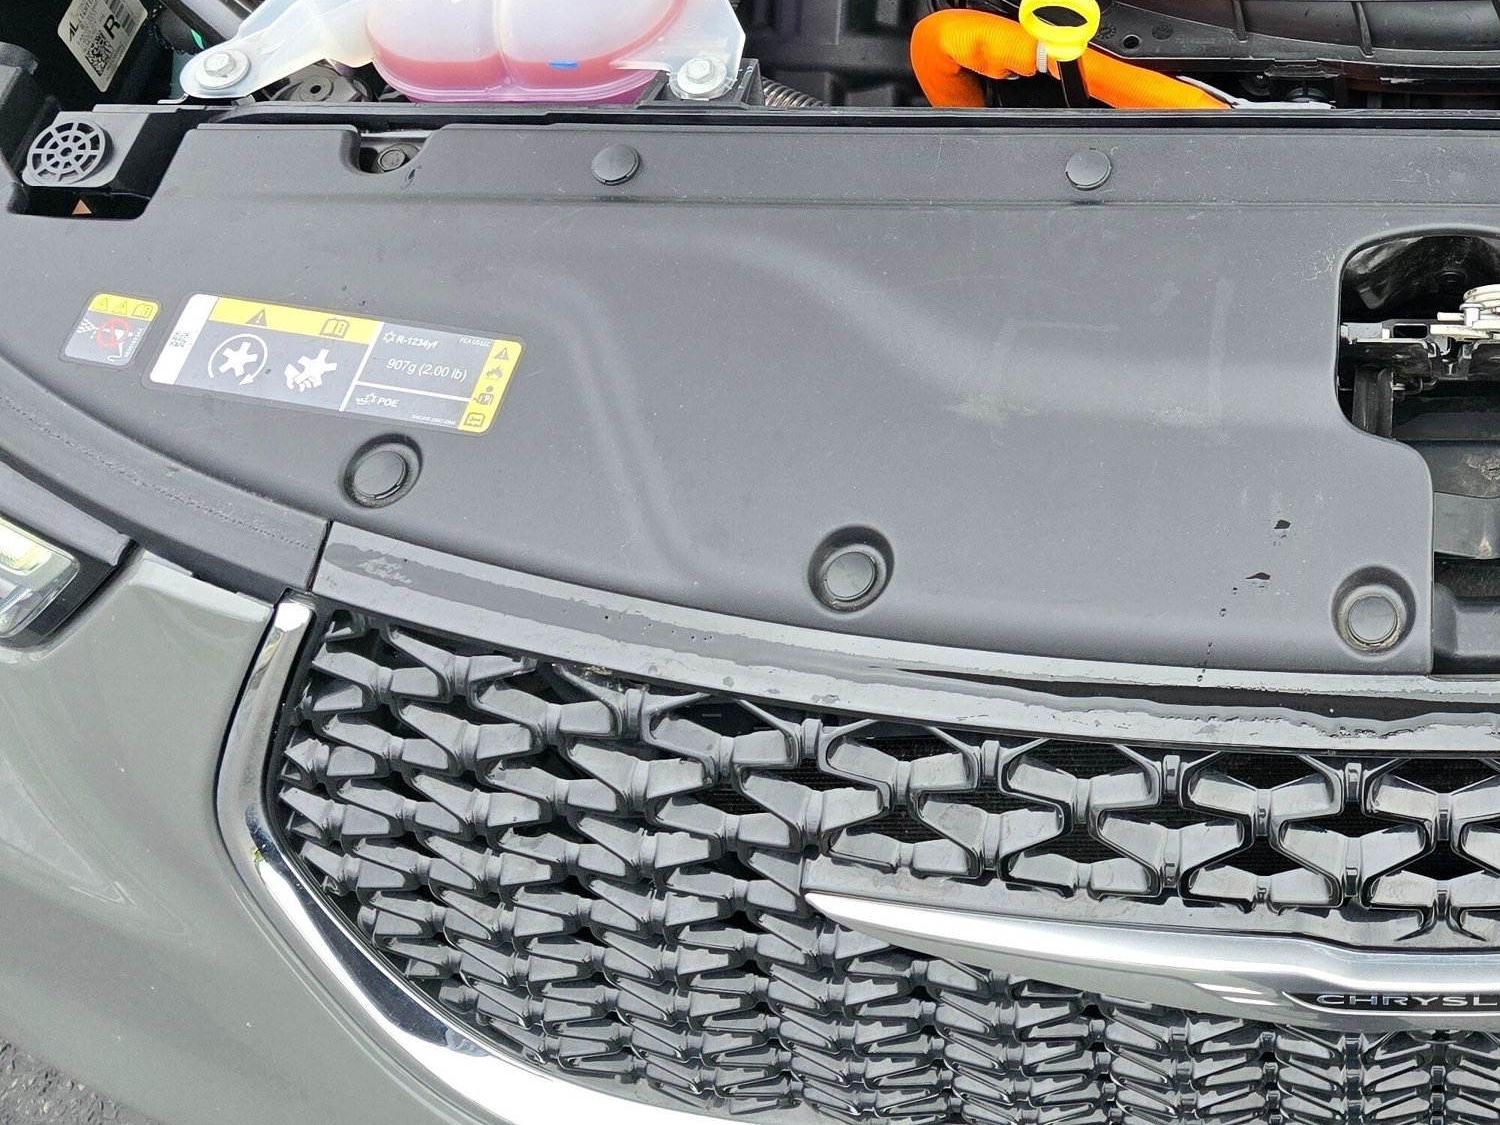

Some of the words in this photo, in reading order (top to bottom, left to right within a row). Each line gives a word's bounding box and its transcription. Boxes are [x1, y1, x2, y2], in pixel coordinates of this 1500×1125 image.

[102, 13, 121, 40] R
[396, 335, 439, 351] R-1234yf
[386, 358, 417, 375] 907g
[418, 363, 449, 378] (2.00
[450, 367, 468, 382] lb)
[377, 396, 399, 408] POE
